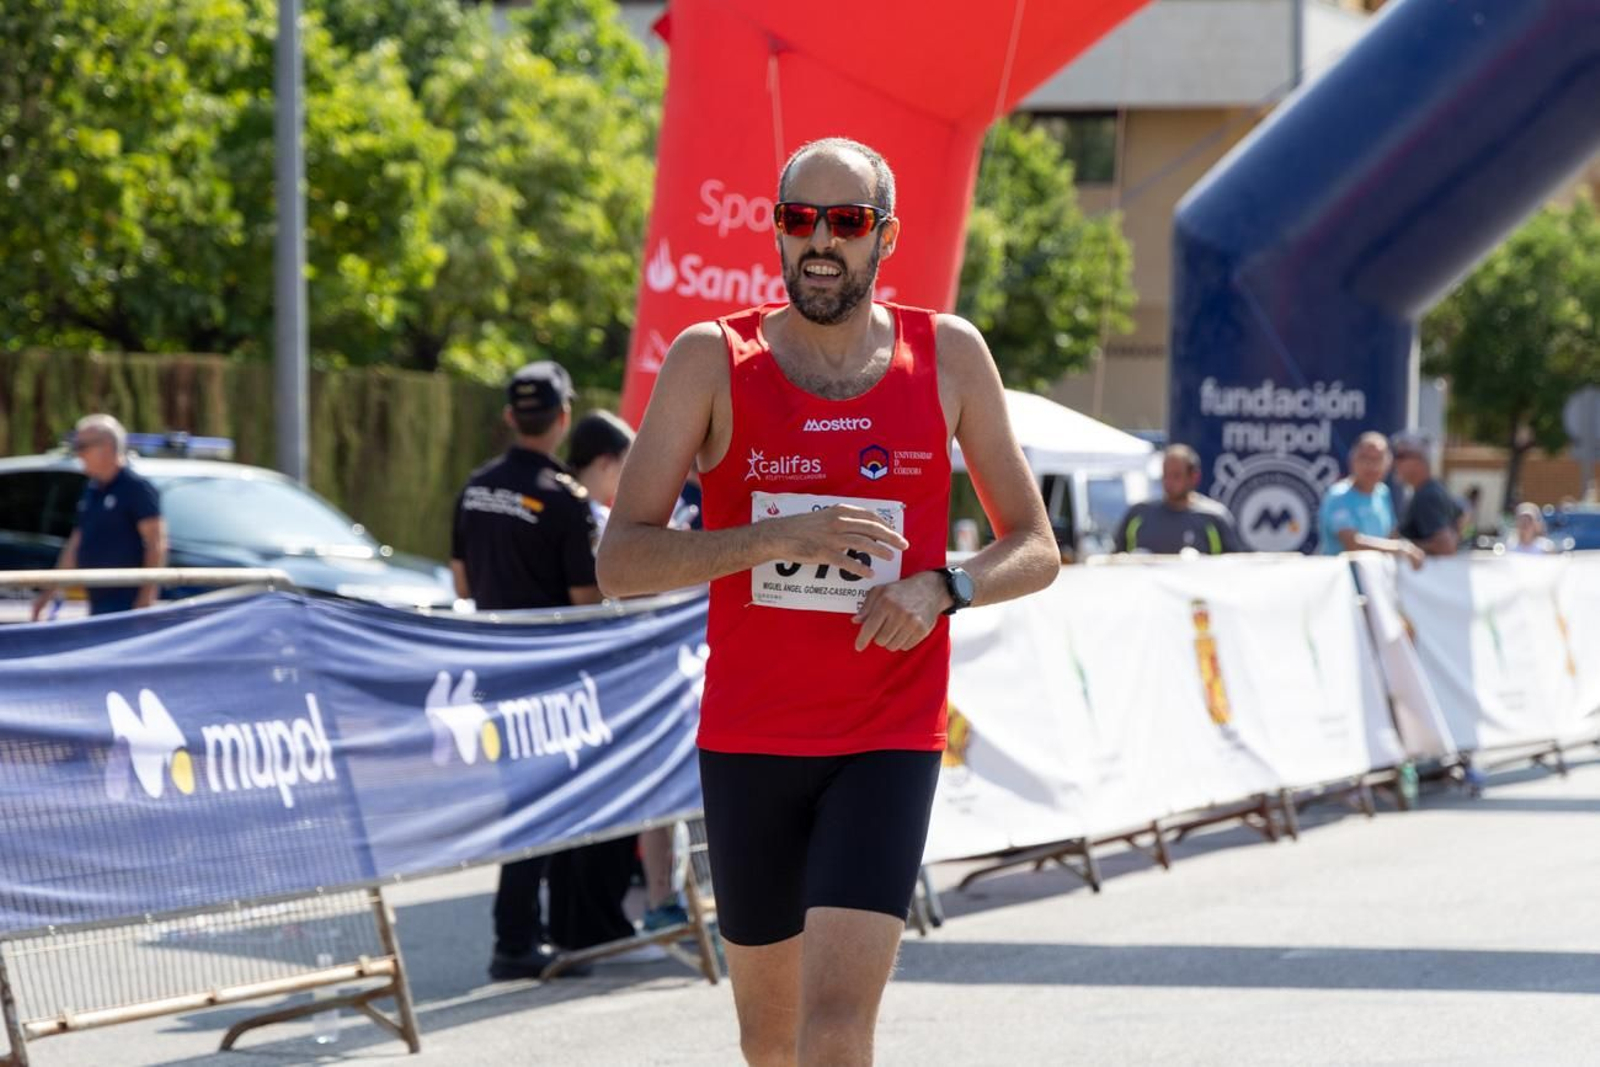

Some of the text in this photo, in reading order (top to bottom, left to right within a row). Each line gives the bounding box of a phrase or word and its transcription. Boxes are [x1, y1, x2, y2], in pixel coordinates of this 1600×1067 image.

[1201, 376, 1366, 420] fundación
[1222, 419, 1332, 459] mupol
[758, 455, 822, 474] califas
[762, 582, 782, 592] MIGUEL
[499, 670, 613, 770] mupol
[201, 692, 336, 808] mupol
